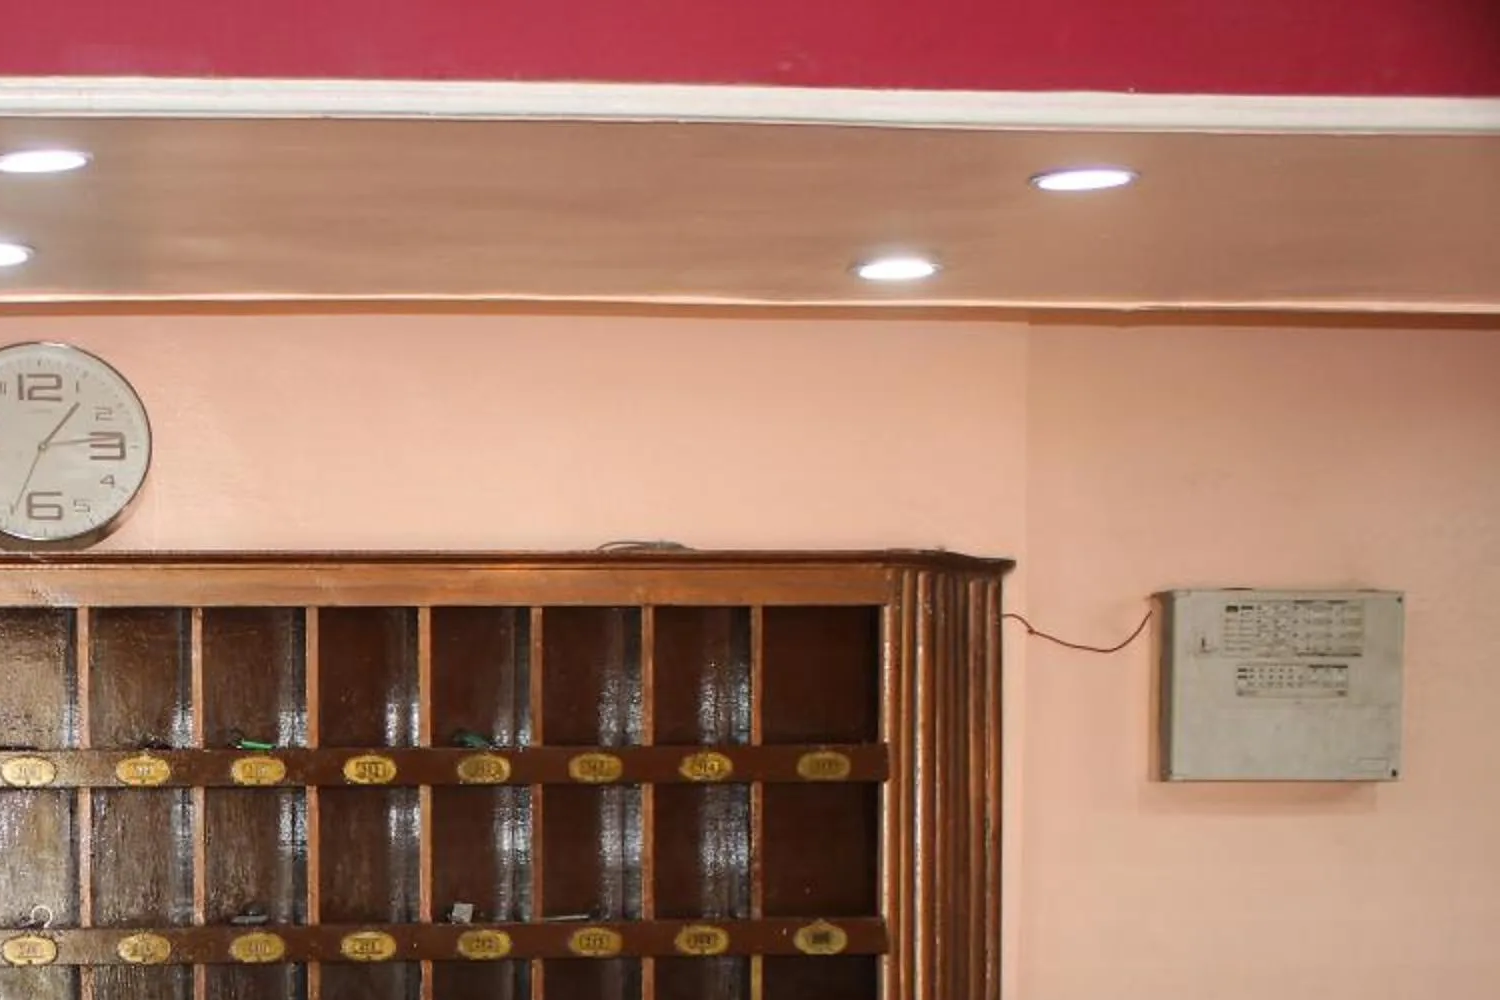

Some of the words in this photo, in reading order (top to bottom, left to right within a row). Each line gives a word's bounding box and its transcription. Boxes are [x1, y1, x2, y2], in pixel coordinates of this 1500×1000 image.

[0, 381, 7, 395] 11
[18, 373, 62, 402] 12
[94, 407, 114, 421] 2
[89, 432, 126, 460] 3
[100, 474, 115, 488] 4
[27, 492, 63, 520] 6
[73, 500, 91, 513] 5
